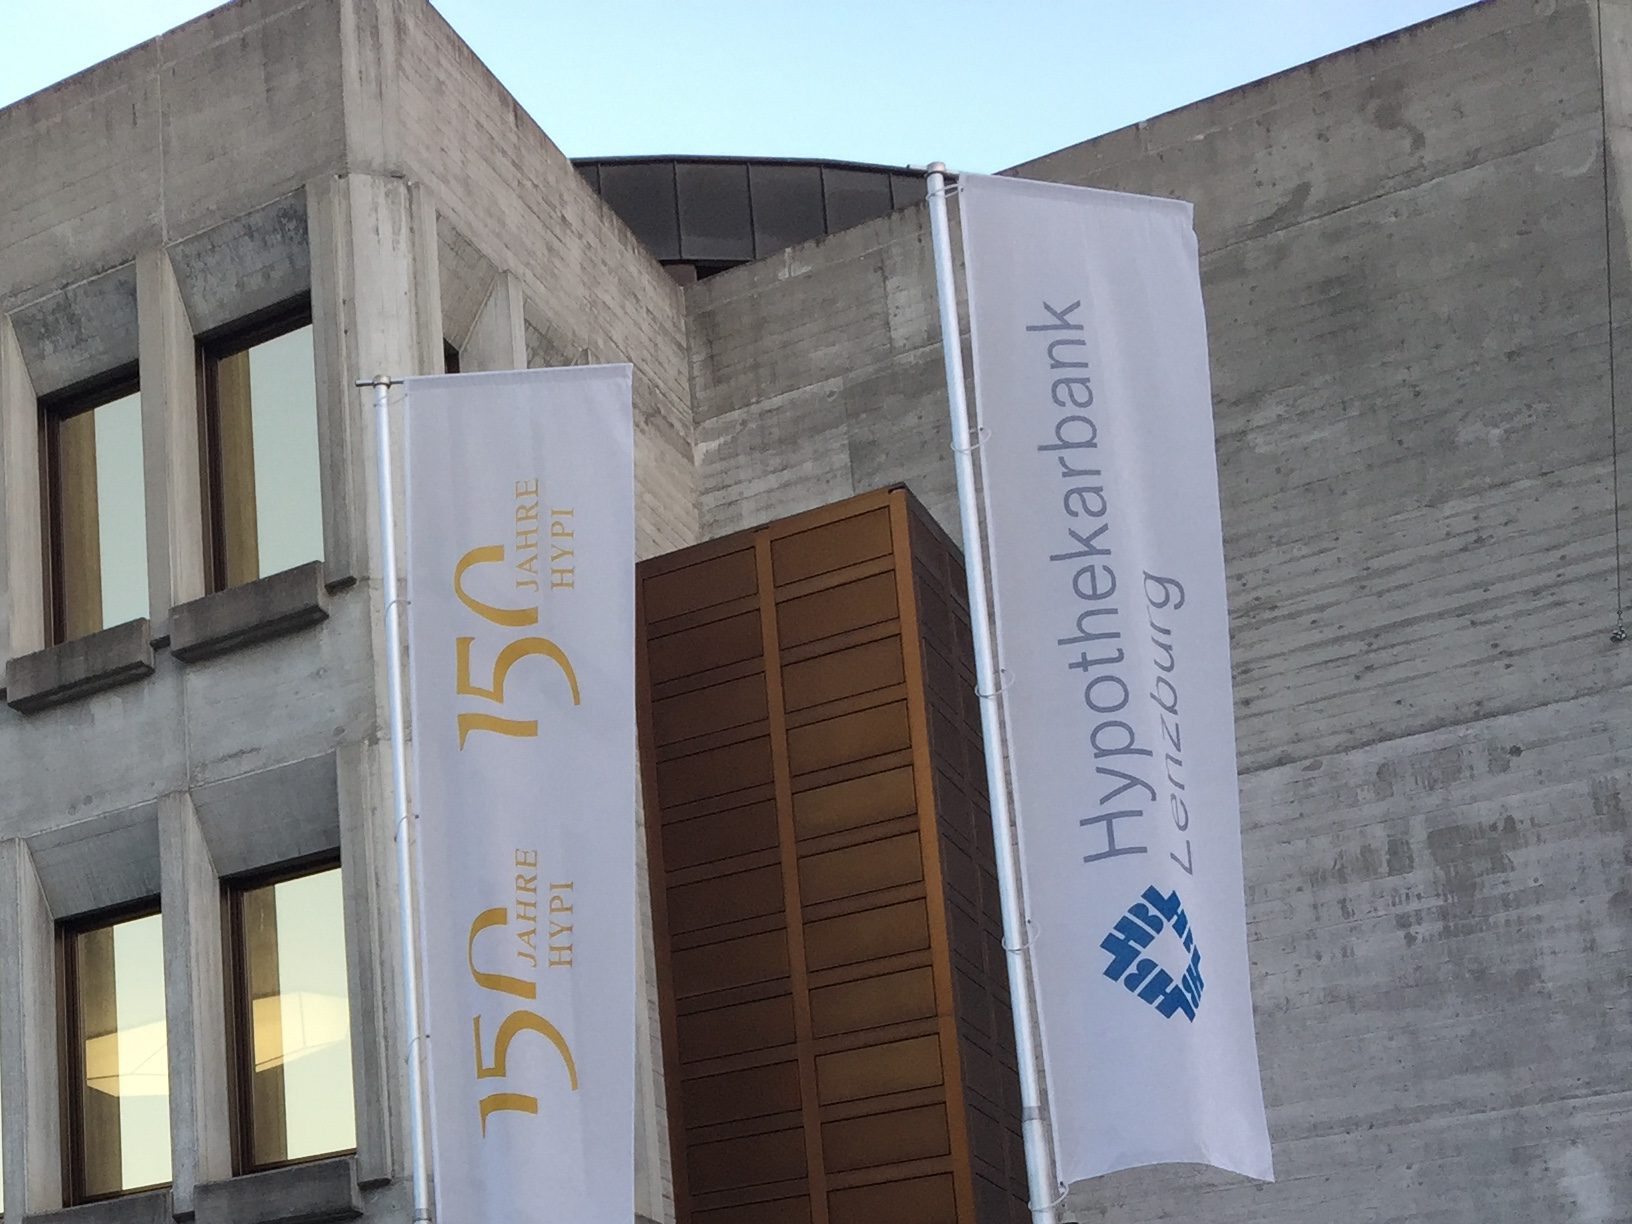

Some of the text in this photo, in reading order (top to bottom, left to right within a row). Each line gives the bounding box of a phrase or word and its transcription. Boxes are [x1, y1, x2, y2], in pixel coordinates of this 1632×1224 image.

[515, 478, 539, 592] JAHRE
[550, 507, 575, 590] HYPI
[1025, 299, 1157, 864] Hypothekarbank
[454, 544, 581, 752] 150
[1142, 569, 1194, 876] Lenzburg
[515, 848, 538, 968] JAHRE
[548, 880, 574, 968] HYPI
[468, 907, 579, 1138] 150
